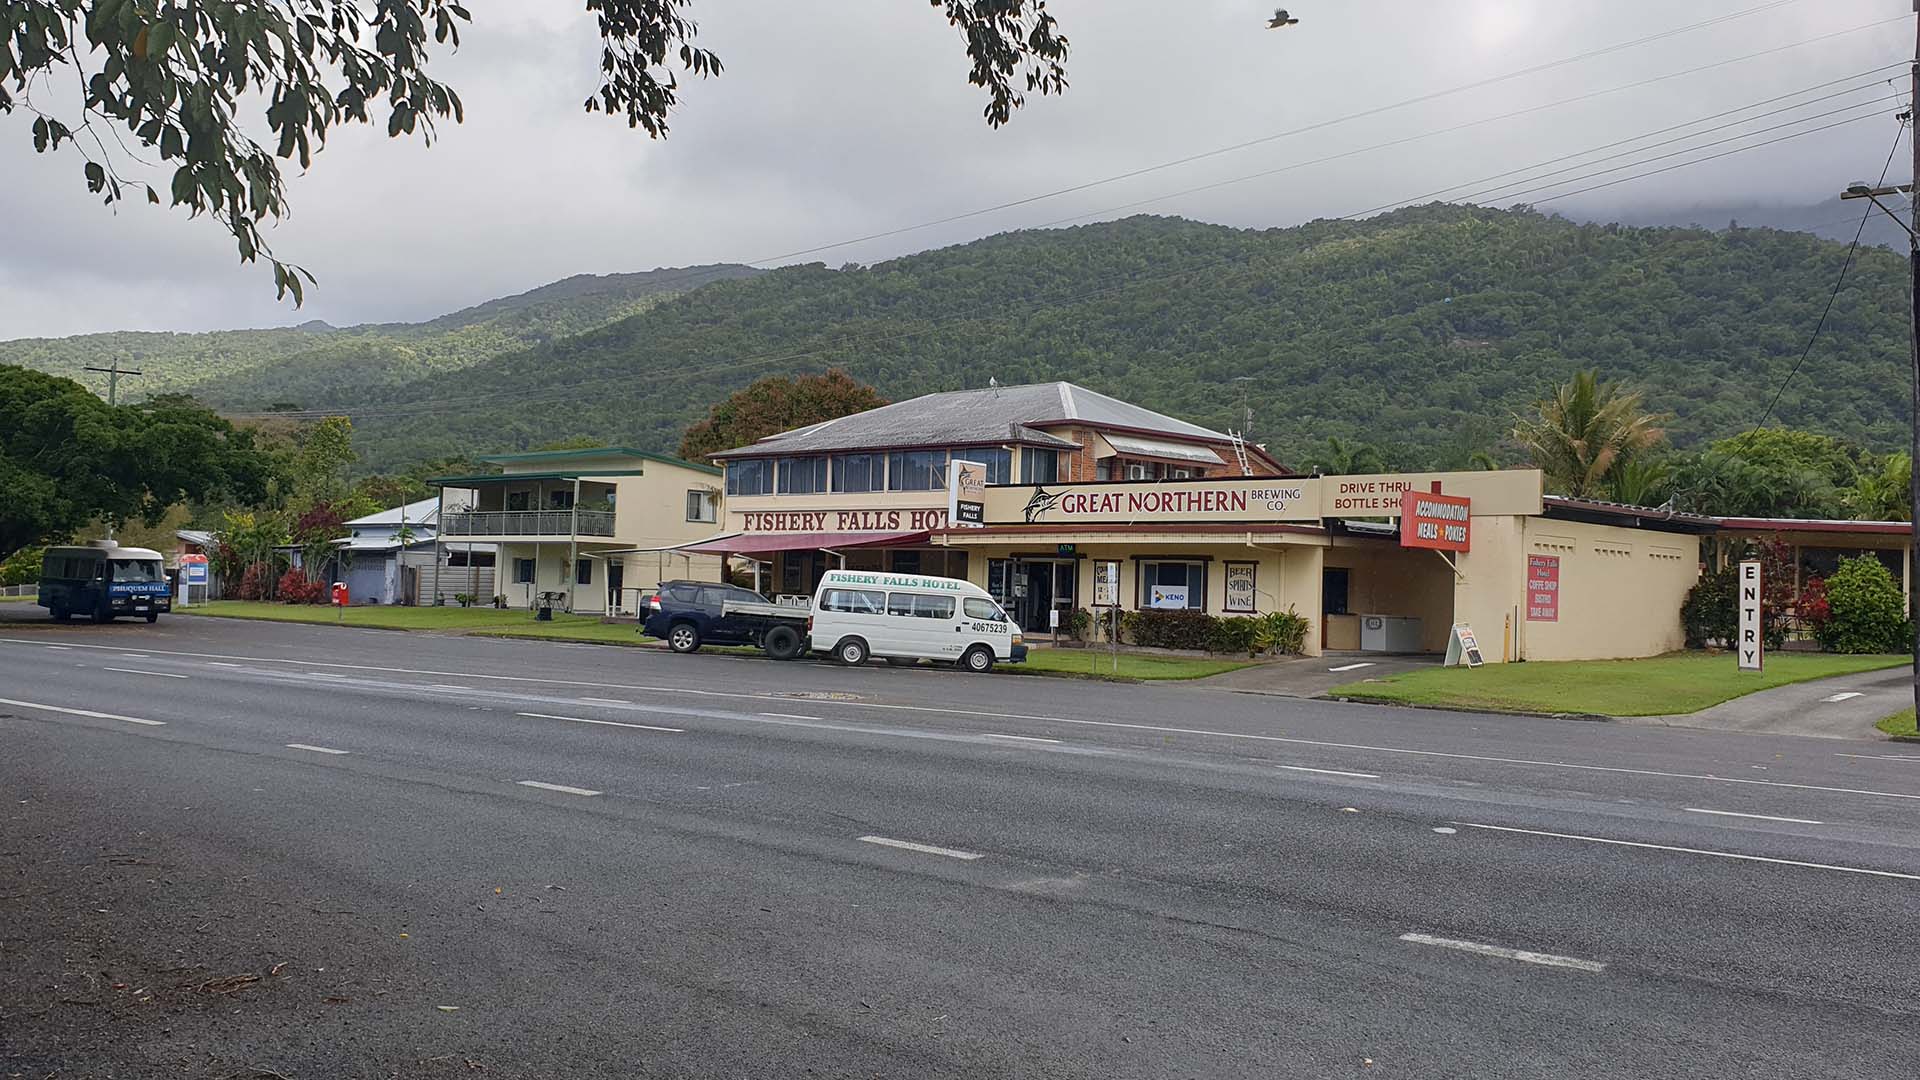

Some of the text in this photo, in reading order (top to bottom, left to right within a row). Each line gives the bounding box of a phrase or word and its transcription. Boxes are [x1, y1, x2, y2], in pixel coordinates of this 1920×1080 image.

[965, 478, 984, 487] GREAT
[1340, 481, 1412, 494] DRIVE THRU
[1061, 489, 1301, 513] GREAT NORTHERN BREWING CO.
[1335, 498, 1379, 509] BOTTLE
[960, 504, 981, 512] FISHERY
[1416, 500, 1469, 522] ACCOMMODATION
[743, 510, 949, 531] FISHERY FALLS HOT
[962, 512, 978, 520] FALLS
[1417, 523, 1467, 543] MEALS POKIES
[1229, 567, 1253, 579] BEER
[830, 573, 961, 591] FISHERY FALLS HOTEL
[1229, 579, 1253, 592] SPIRITS
[1165, 593, 1185, 601] KENO
[1229, 594, 1252, 607] WINE
[1744, 566, 1755, 664] ENTRY
[971, 621, 1008, 634] 40675239
